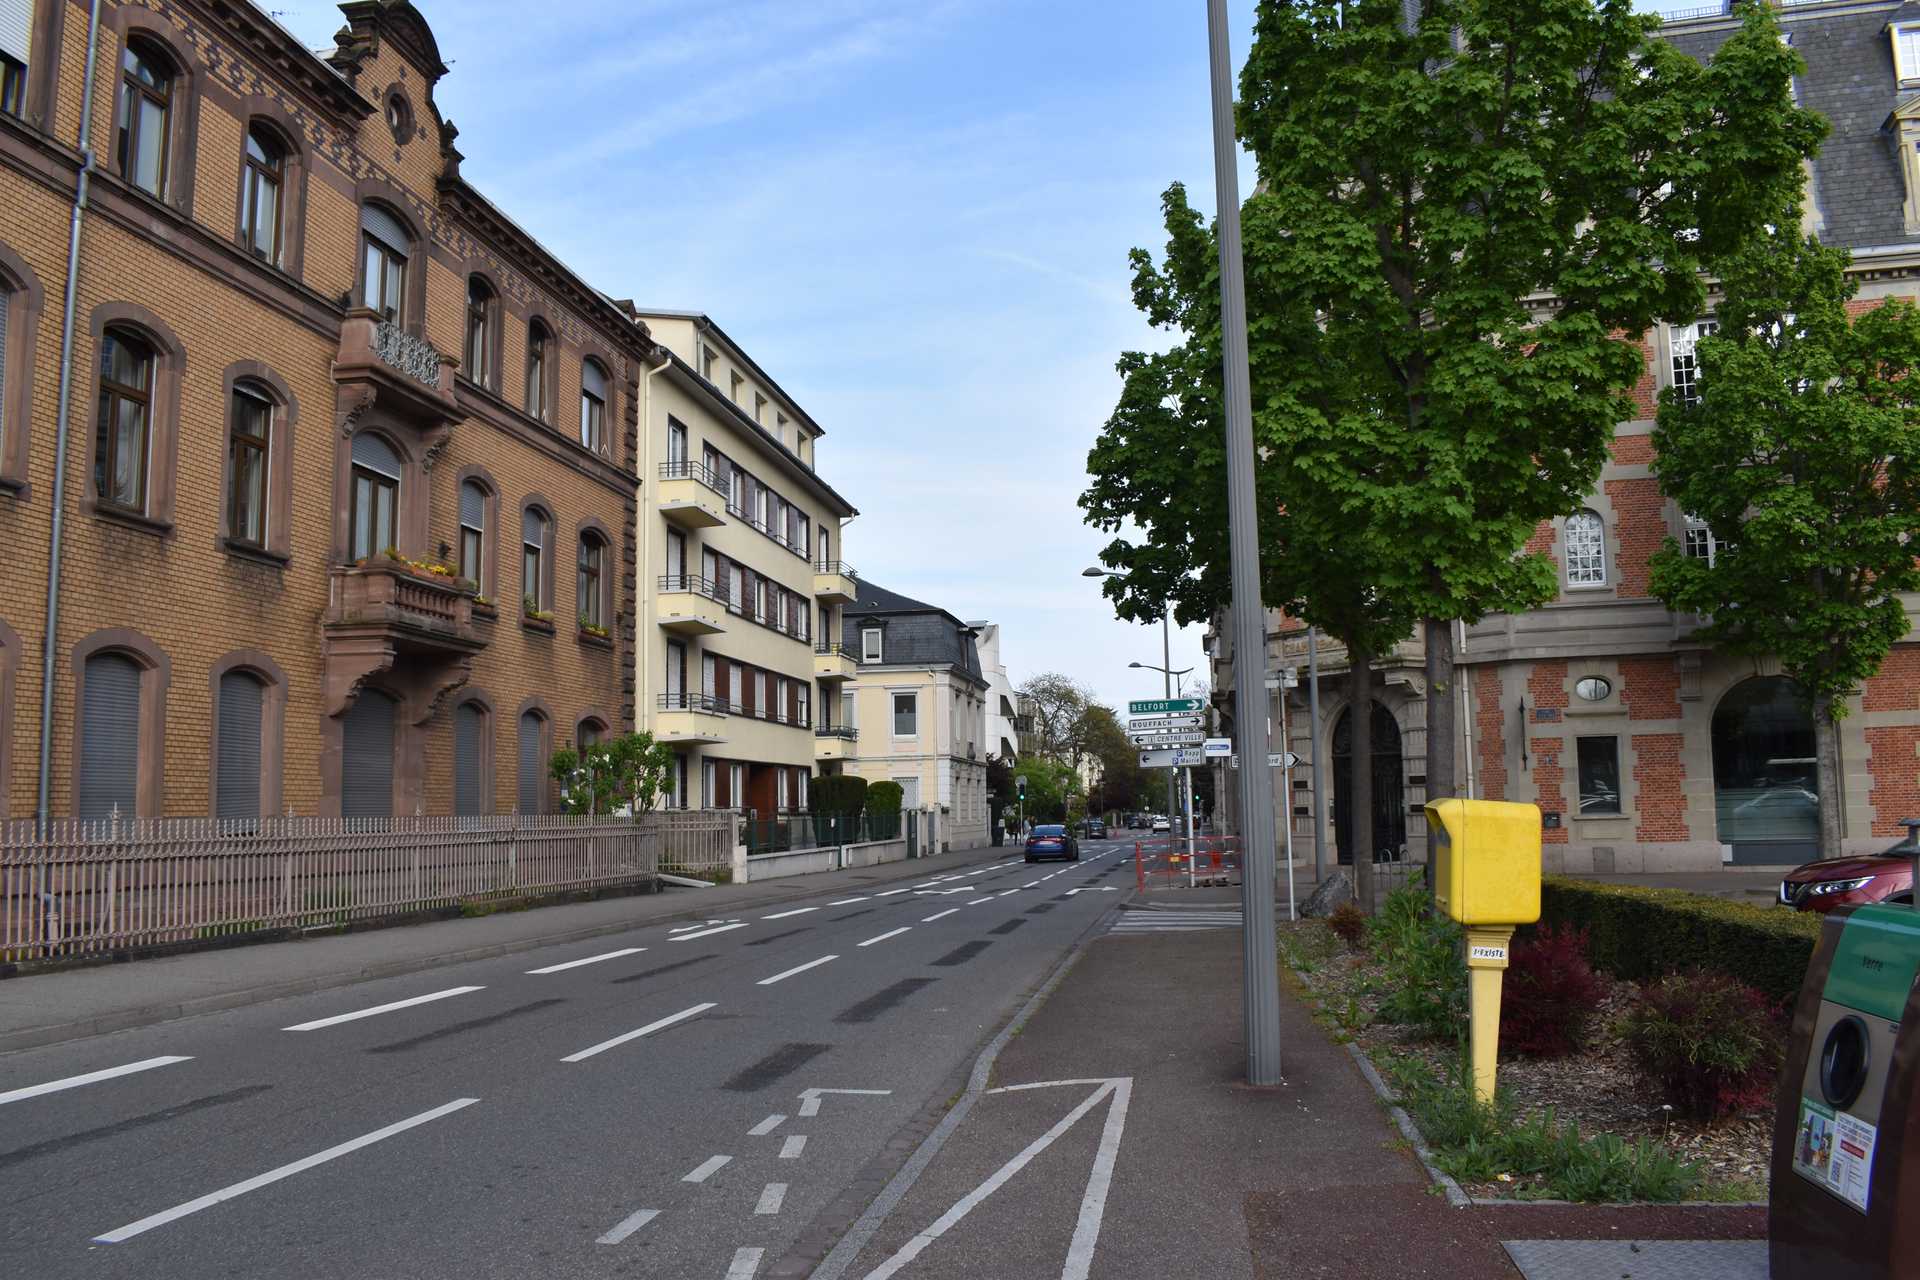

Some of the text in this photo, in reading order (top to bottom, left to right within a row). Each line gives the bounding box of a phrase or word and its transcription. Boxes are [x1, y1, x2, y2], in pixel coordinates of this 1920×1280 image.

[1131, 702, 1169, 711] BELFORT
[1132, 719, 1172, 728] ROUFFACH
[1157, 735, 1182, 743] CENTRE
[1184, 733, 1202, 741] VILLE
